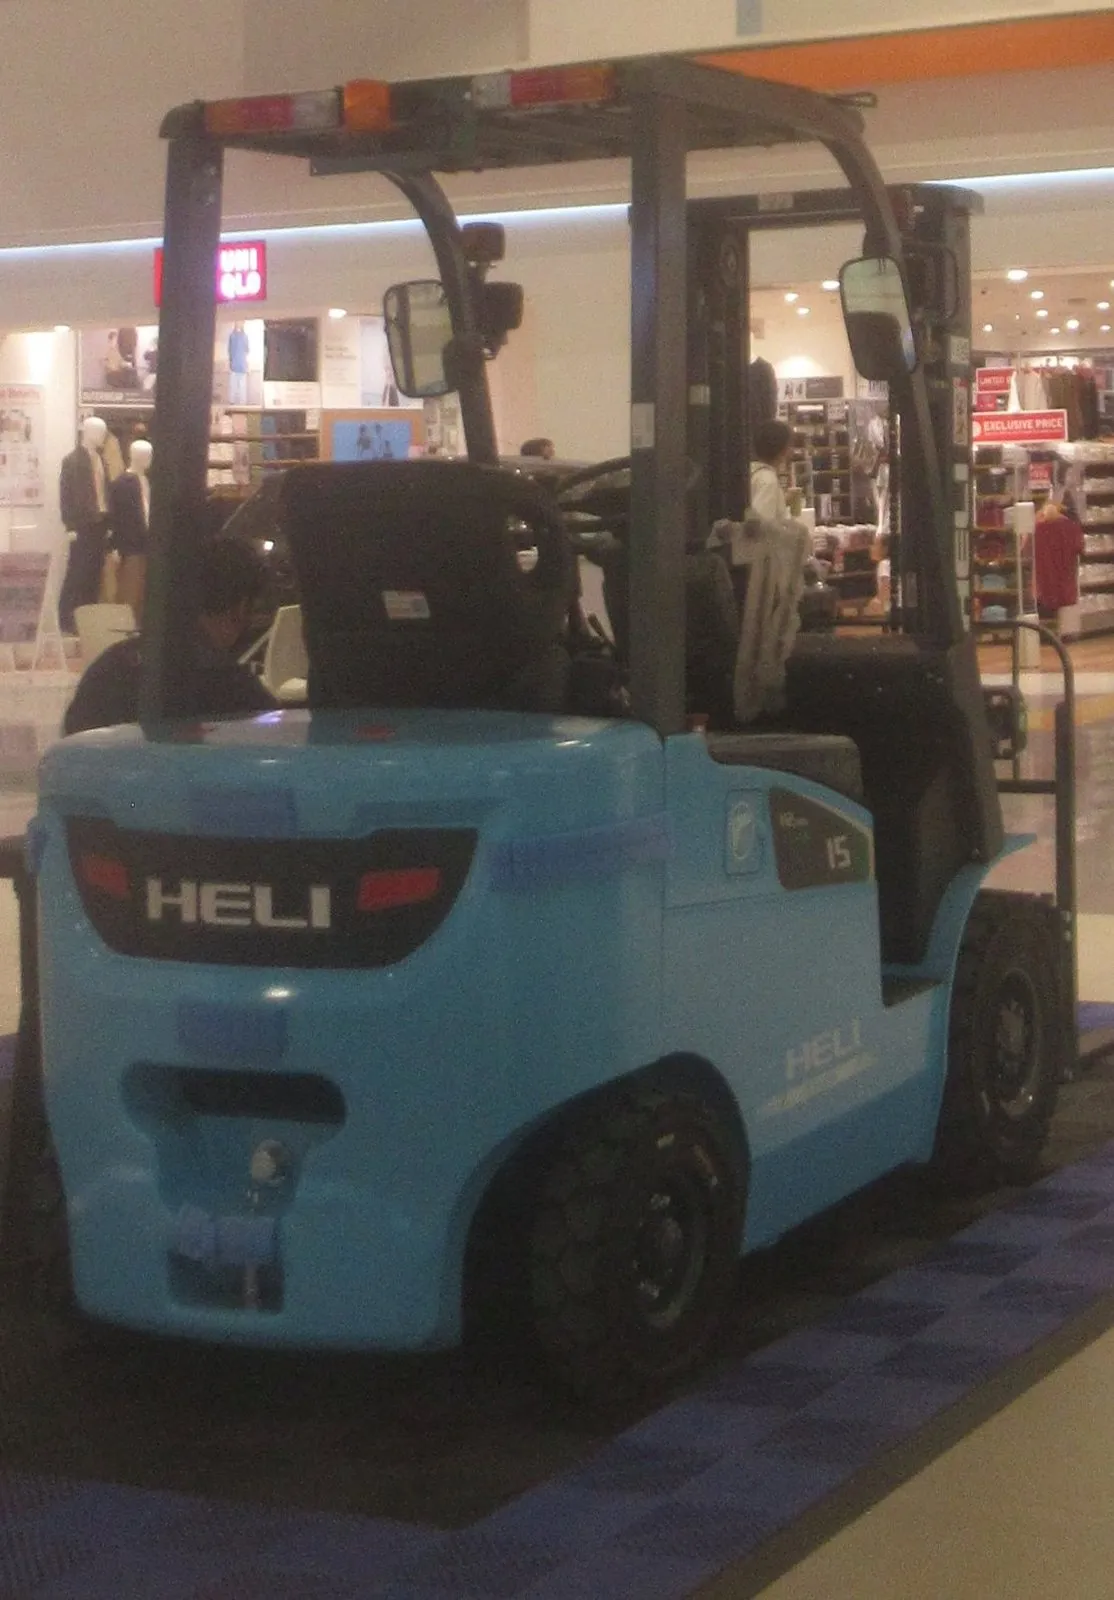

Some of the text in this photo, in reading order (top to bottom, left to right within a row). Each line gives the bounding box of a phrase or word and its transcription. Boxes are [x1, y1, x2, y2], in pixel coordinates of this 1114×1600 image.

[983, 417, 1064, 431] EXCLUSIVE PRICE
[826, 835, 851, 869] 15
[146, 877, 331, 929] HELI
[785, 1017, 862, 1081] HELI
